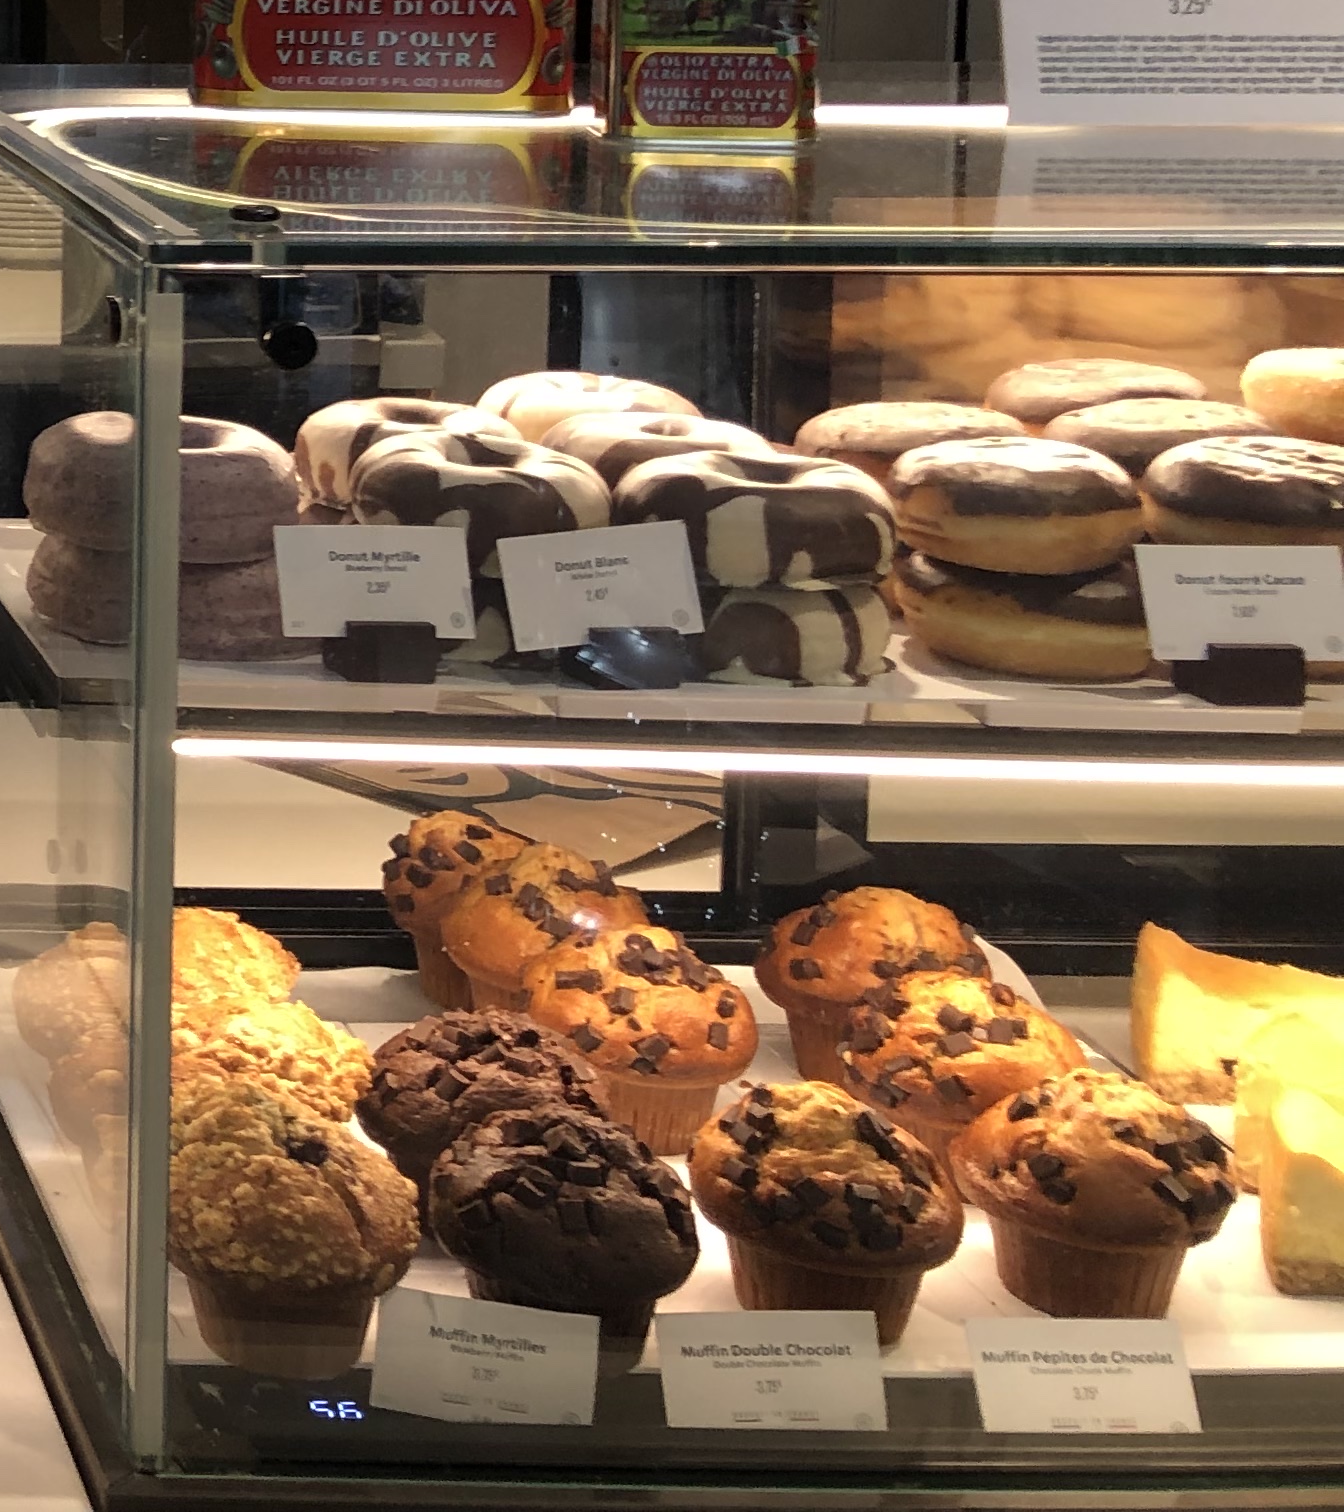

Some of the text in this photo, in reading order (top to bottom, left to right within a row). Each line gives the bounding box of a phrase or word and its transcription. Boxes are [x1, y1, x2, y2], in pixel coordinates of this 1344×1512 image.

[257, 0, 517, 17] VERGINE DI OLIVA
[275, 30, 497, 48] HUILE D'OLIVE
[276, 49, 496, 68] VIERGE EXTRA
[329, 551, 368, 563] Donut
[681, 1344, 851, 1358] Muffin Double Chocolat
